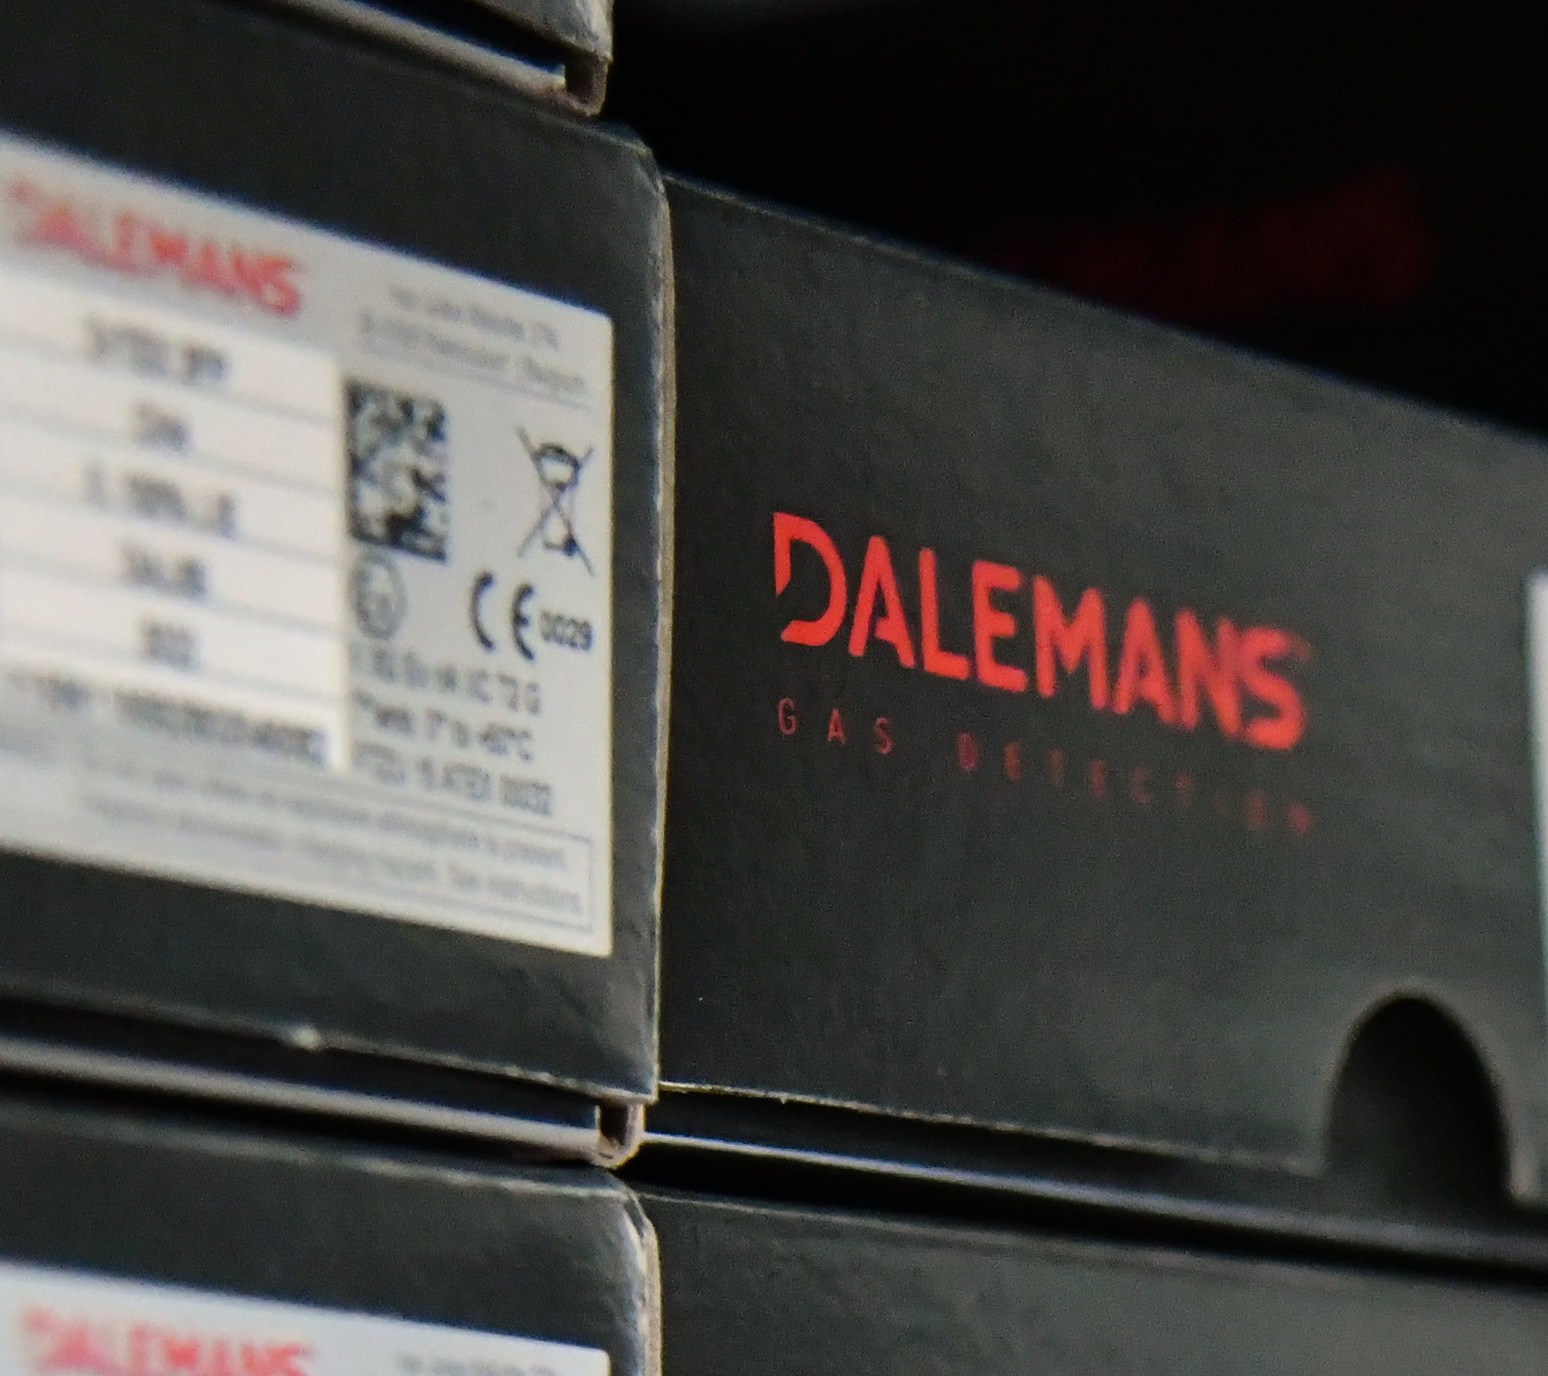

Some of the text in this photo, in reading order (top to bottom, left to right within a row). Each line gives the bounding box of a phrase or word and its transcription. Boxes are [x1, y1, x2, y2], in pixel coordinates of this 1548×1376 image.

[5, 173, 306, 328] DALEMANS
[540, 612, 592, 654] 0029
[773, 511, 1310, 751] DALEMANS
[777, 697, 893, 755] GAS
